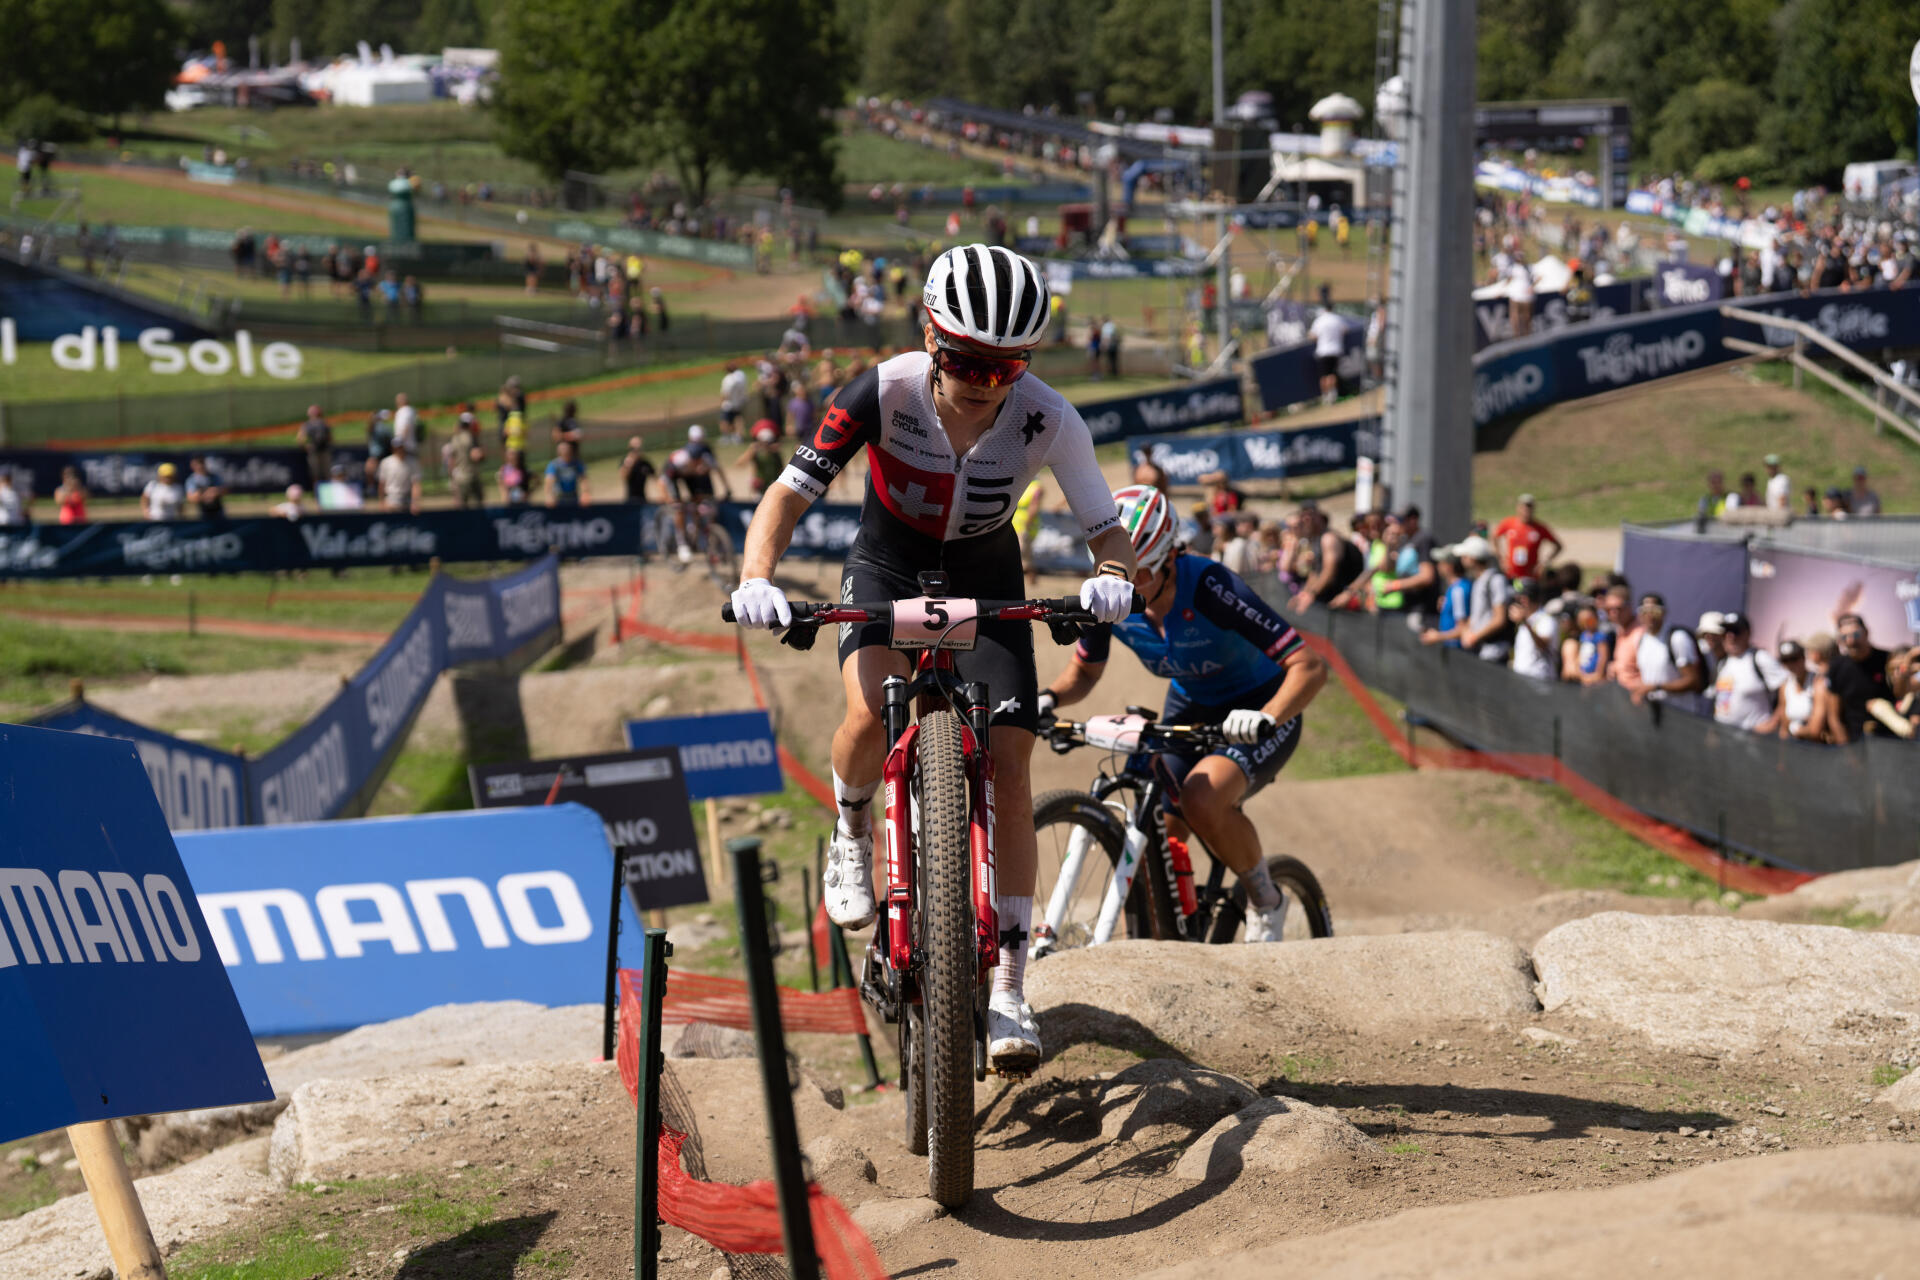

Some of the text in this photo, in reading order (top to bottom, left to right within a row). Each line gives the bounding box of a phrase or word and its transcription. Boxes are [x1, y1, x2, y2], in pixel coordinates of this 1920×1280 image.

[1818, 303, 1888, 342] Sole
[52, 325, 119, 371] di
[139, 327, 303, 379] Sole
[1577, 330, 1706, 384] TRENTINO
[892, 419, 928, 439] CYCLING
[893, 410, 919, 426] SWISS
[796, 445, 840, 477] UDOR
[793, 476, 820, 497] VOLV
[301, 523, 346, 558] Val
[367, 521, 437, 557] Sole
[494, 517, 614, 552] TRENTINO
[1086, 513, 1121, 533] VOLV
[922, 601, 949, 631] 5
[1204, 575, 1282, 633] CASTELLI
[1142, 659, 1223, 678] TALIA
[680, 737, 773, 771] IMANO
[136, 737, 241, 833] MANO
[603, 818, 657, 847] ANO
[623, 848, 696, 883] CTION
[0, 866, 201, 966] MANO
[196, 870, 593, 967] MANO
